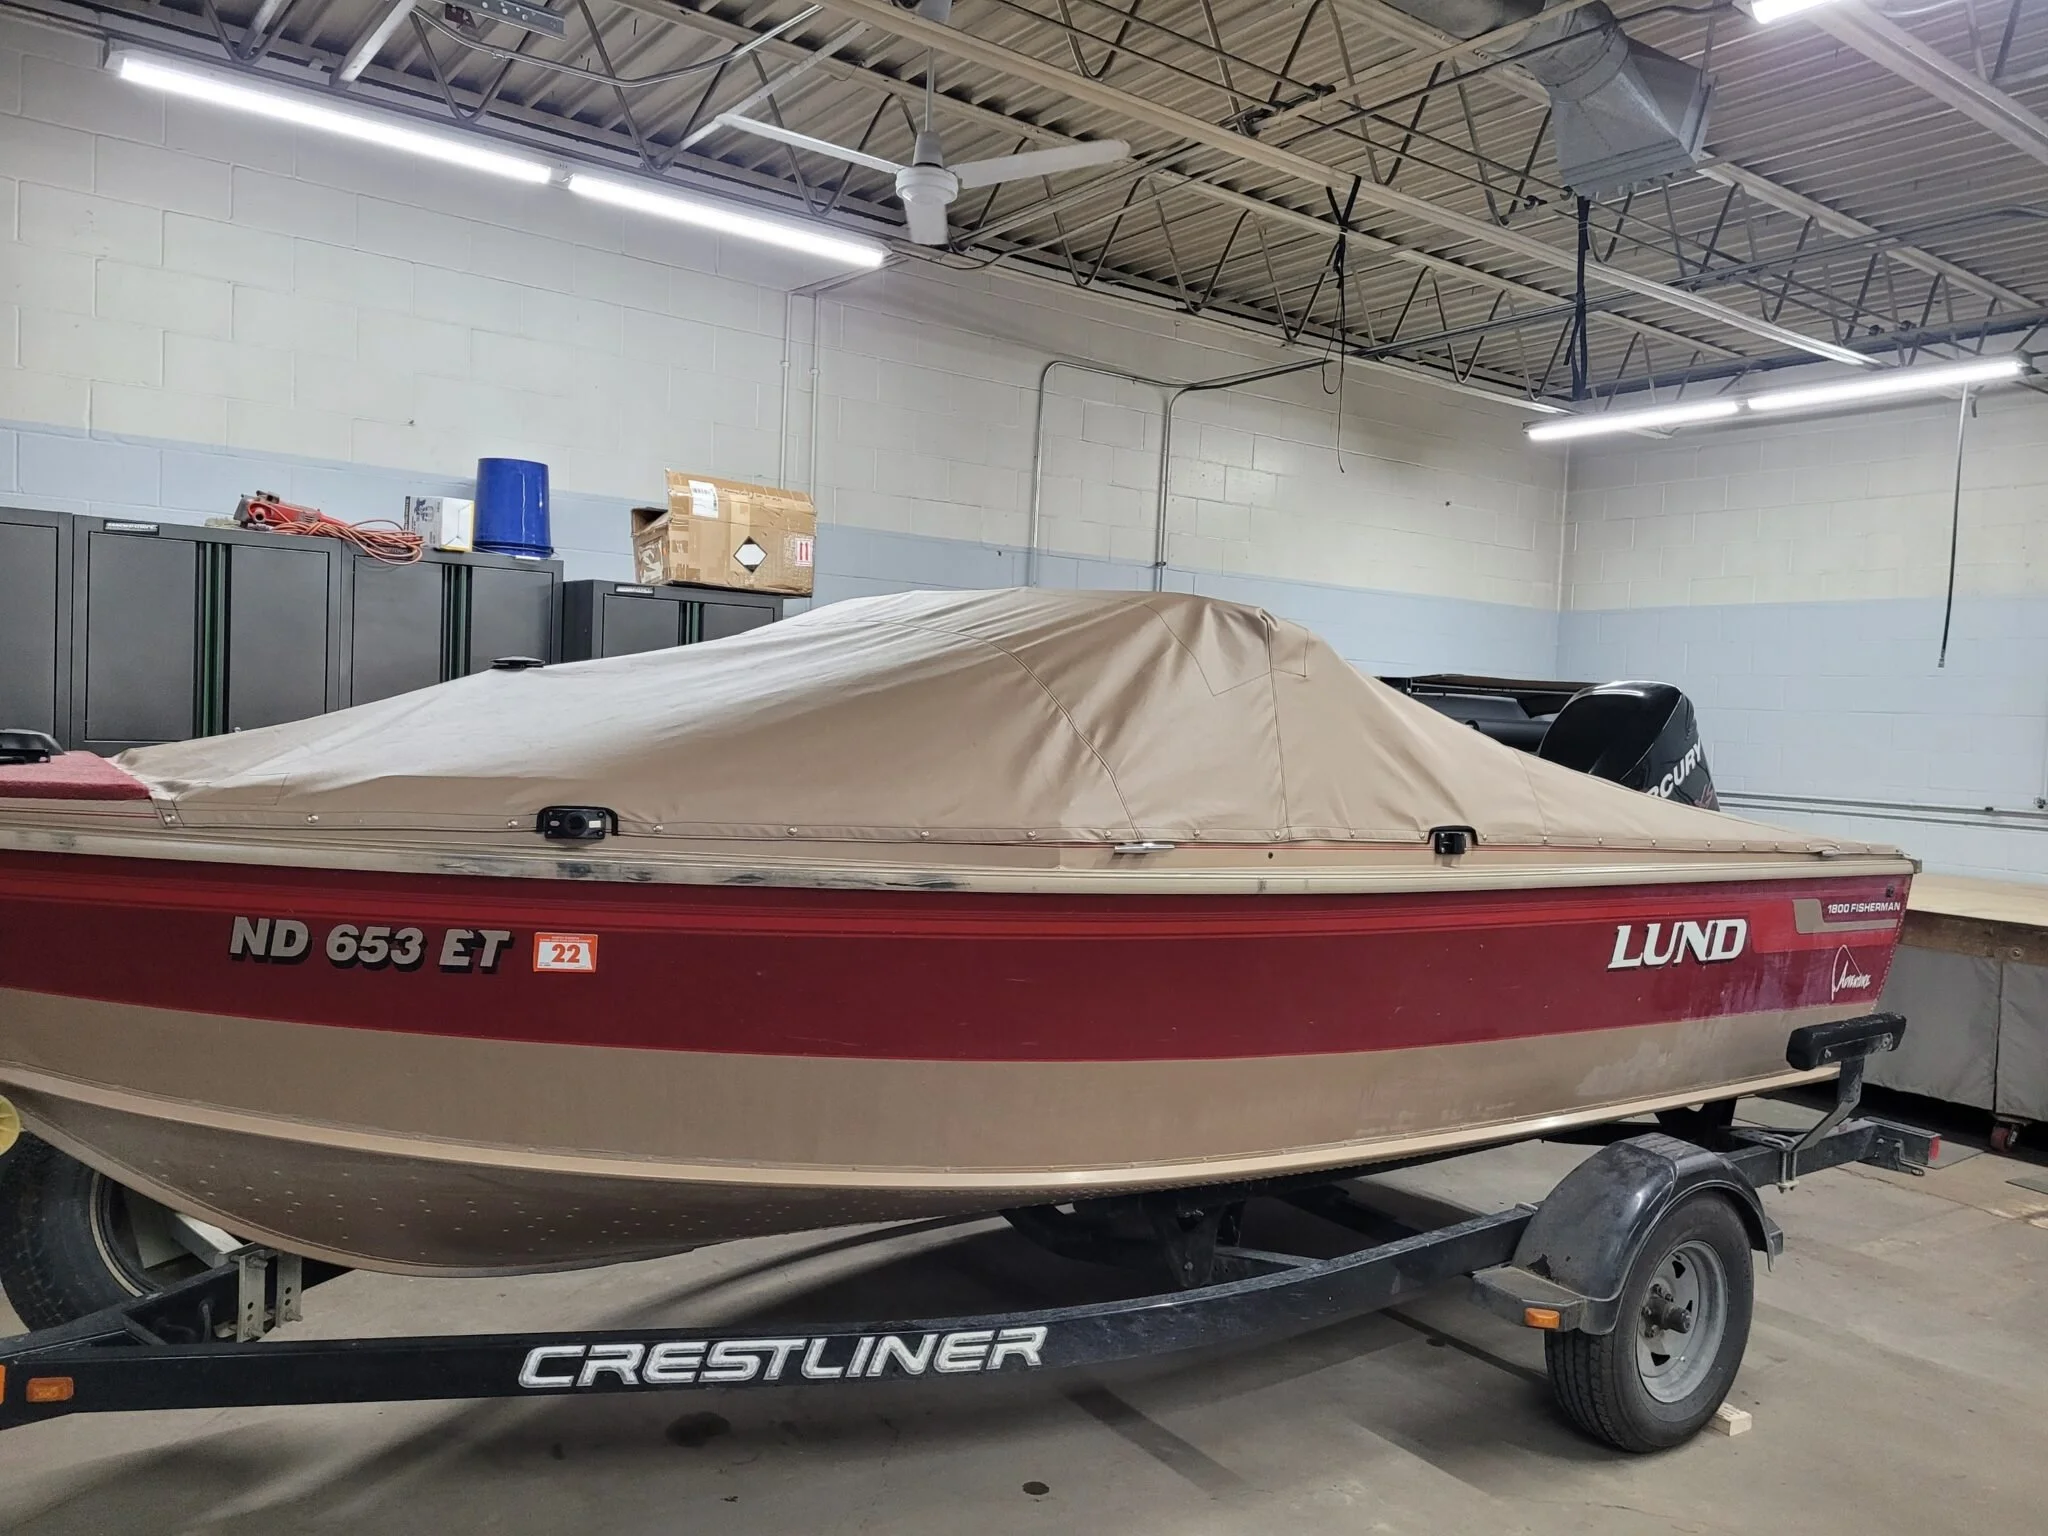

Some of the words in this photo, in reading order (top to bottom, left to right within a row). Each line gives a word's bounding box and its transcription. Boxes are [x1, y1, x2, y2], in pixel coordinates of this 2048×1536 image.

[1827, 903, 1850, 914] 1800
[1850, 901, 1901, 913] FISHERMAN
[229, 916, 310, 960] ND
[325, 923, 425, 966] 653
[438, 928, 513, 970] ET
[551, 943, 581, 964] 22
[1607, 918, 1748, 970] LUND
[517, 1325, 1049, 1389] CRESTLINER
